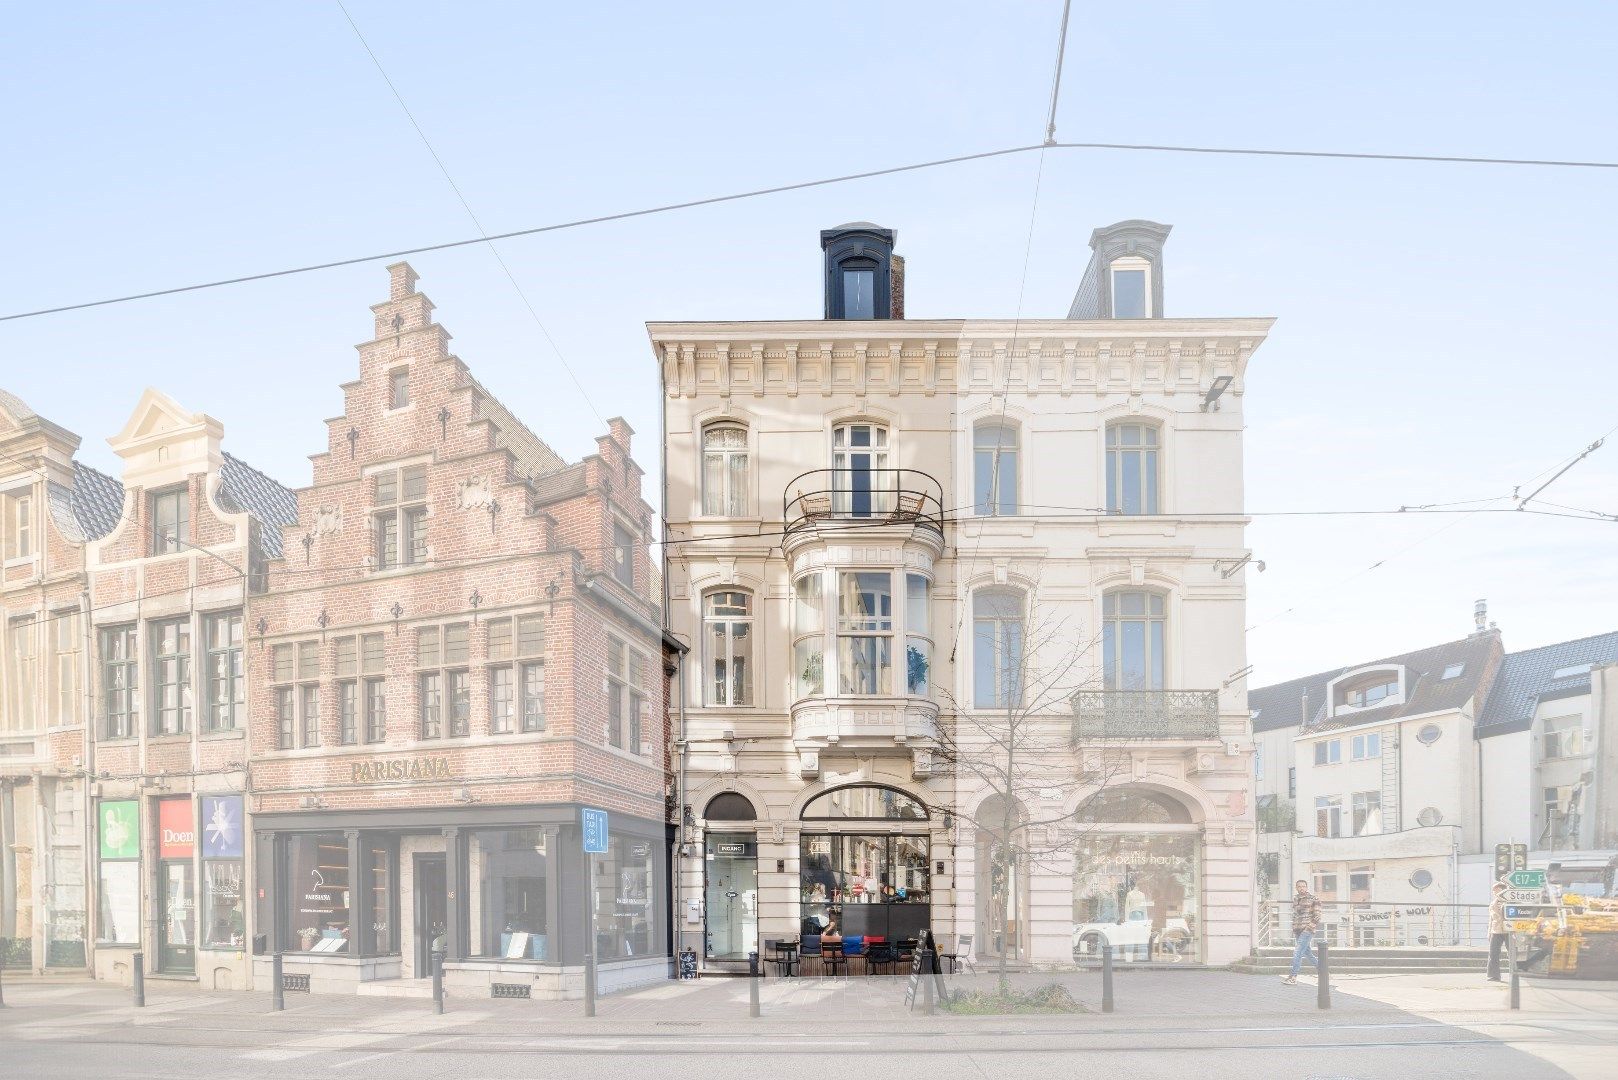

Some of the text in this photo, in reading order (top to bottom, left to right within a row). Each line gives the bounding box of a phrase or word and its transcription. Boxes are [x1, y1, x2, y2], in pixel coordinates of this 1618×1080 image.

[351, 757, 450, 783] PARISIANA
[163, 829, 194, 842] Doen
[1093, 854, 1112, 866] des
[1116, 854, 1146, 867] petits
[1150, 853, 1182, 867] hauts
[1515, 874, 1530, 885] E17
